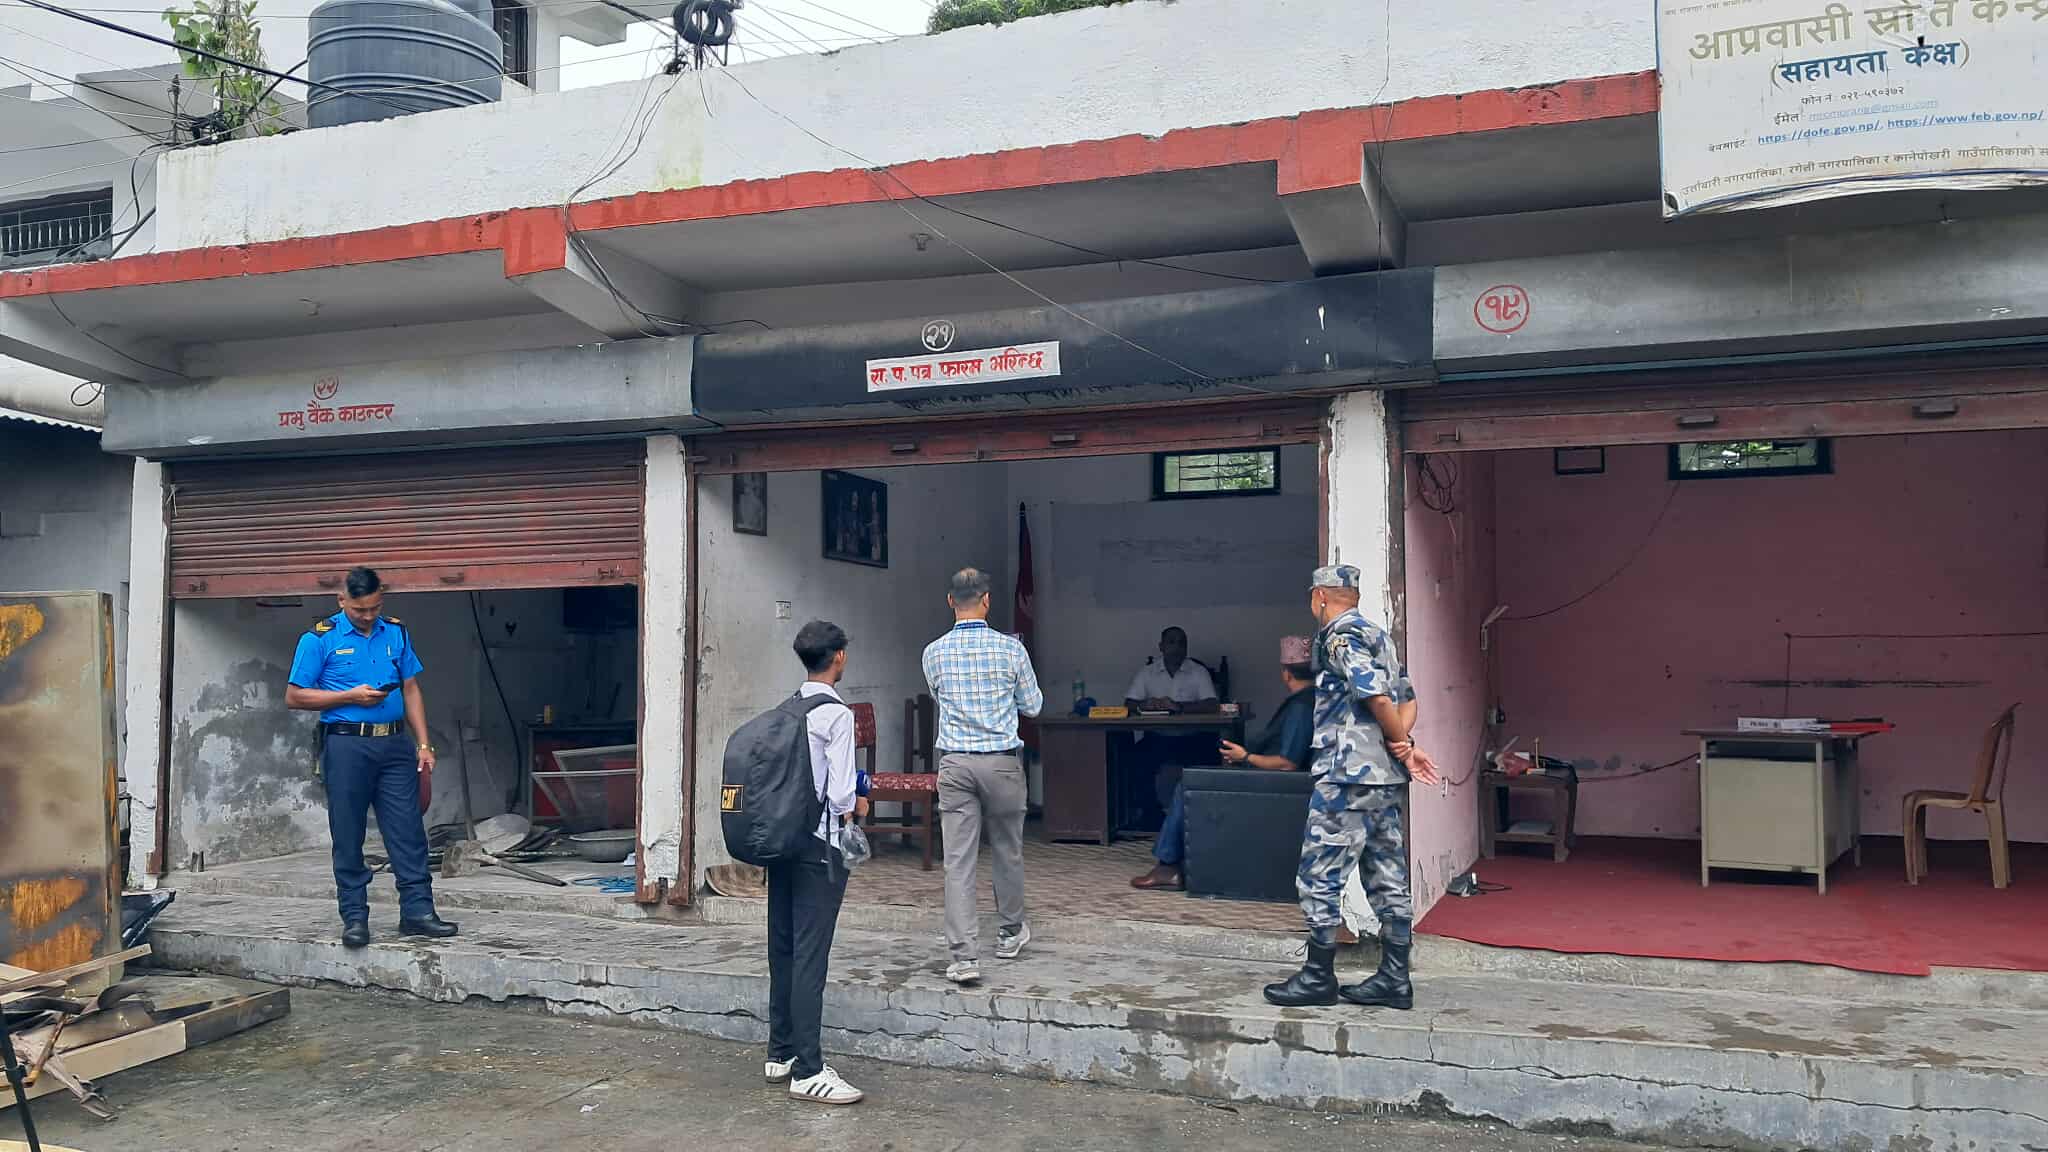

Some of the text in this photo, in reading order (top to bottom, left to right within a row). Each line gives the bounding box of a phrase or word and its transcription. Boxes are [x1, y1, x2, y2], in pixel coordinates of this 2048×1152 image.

[1689, 3, 1853, 60] आप्रवासी
[1771, 51, 1888, 90] (सहायता
[909, 365, 932, 380] पत्र
[721, 788, 737, 809] CAT
